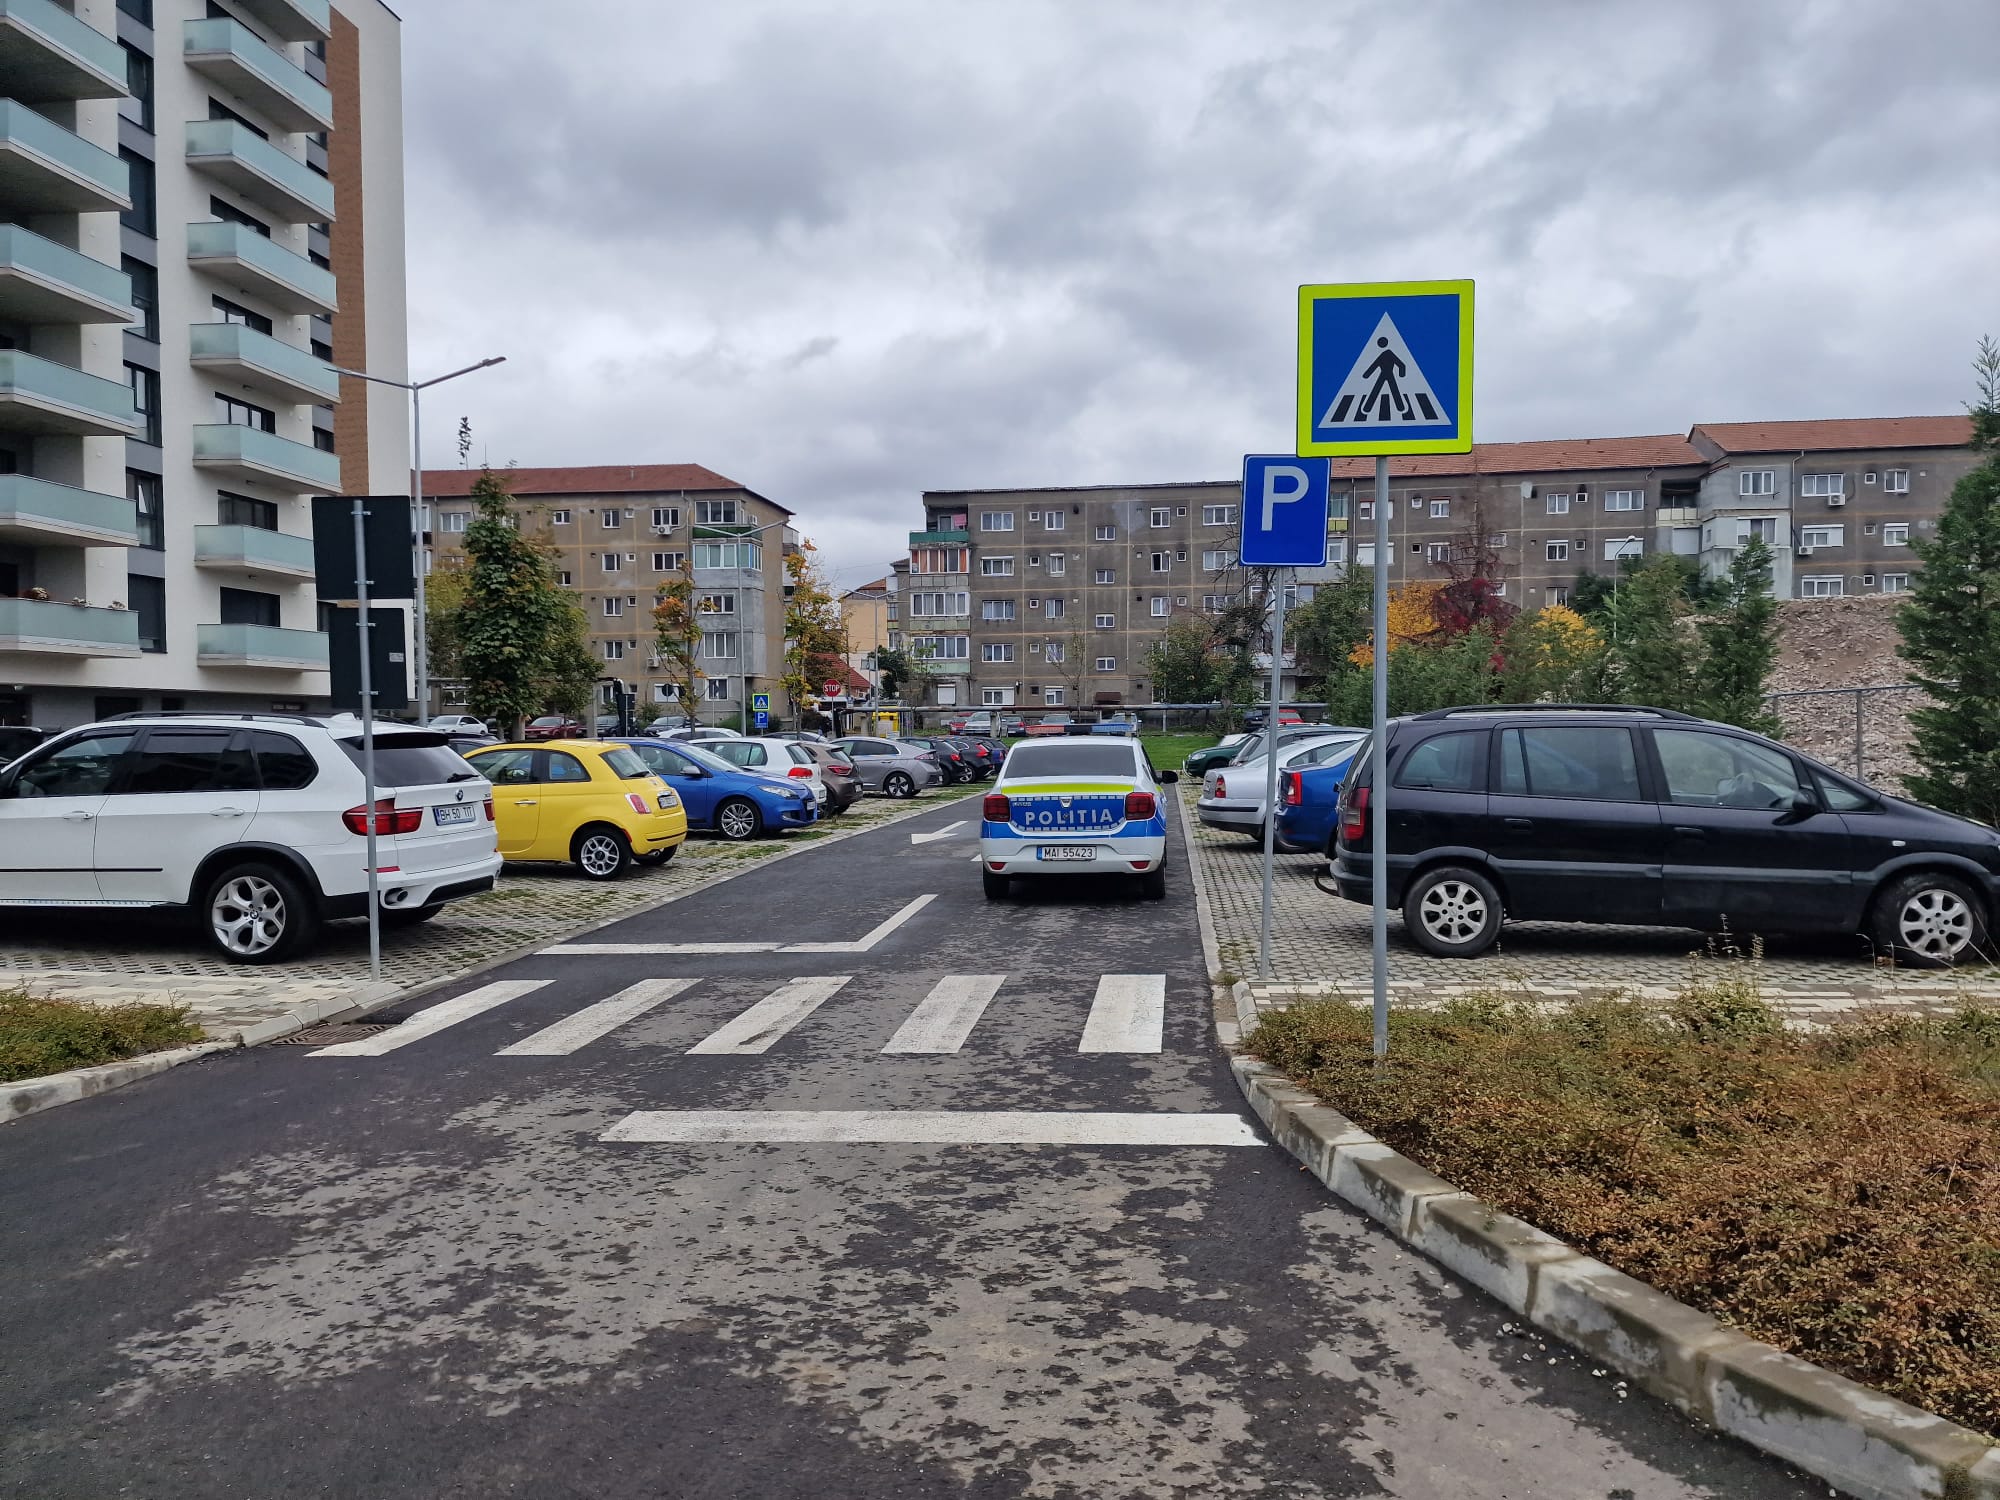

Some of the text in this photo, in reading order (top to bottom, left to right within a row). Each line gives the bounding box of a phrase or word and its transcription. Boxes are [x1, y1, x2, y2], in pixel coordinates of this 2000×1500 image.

[1261, 465, 1309, 531] P
[824, 684, 840, 692] STOP
[757, 712, 766, 722] P
[439, 808, 450, 820] BH
[1025, 808, 1113, 825] POLITIA
[1044, 847, 1093, 857] MAI 55423
